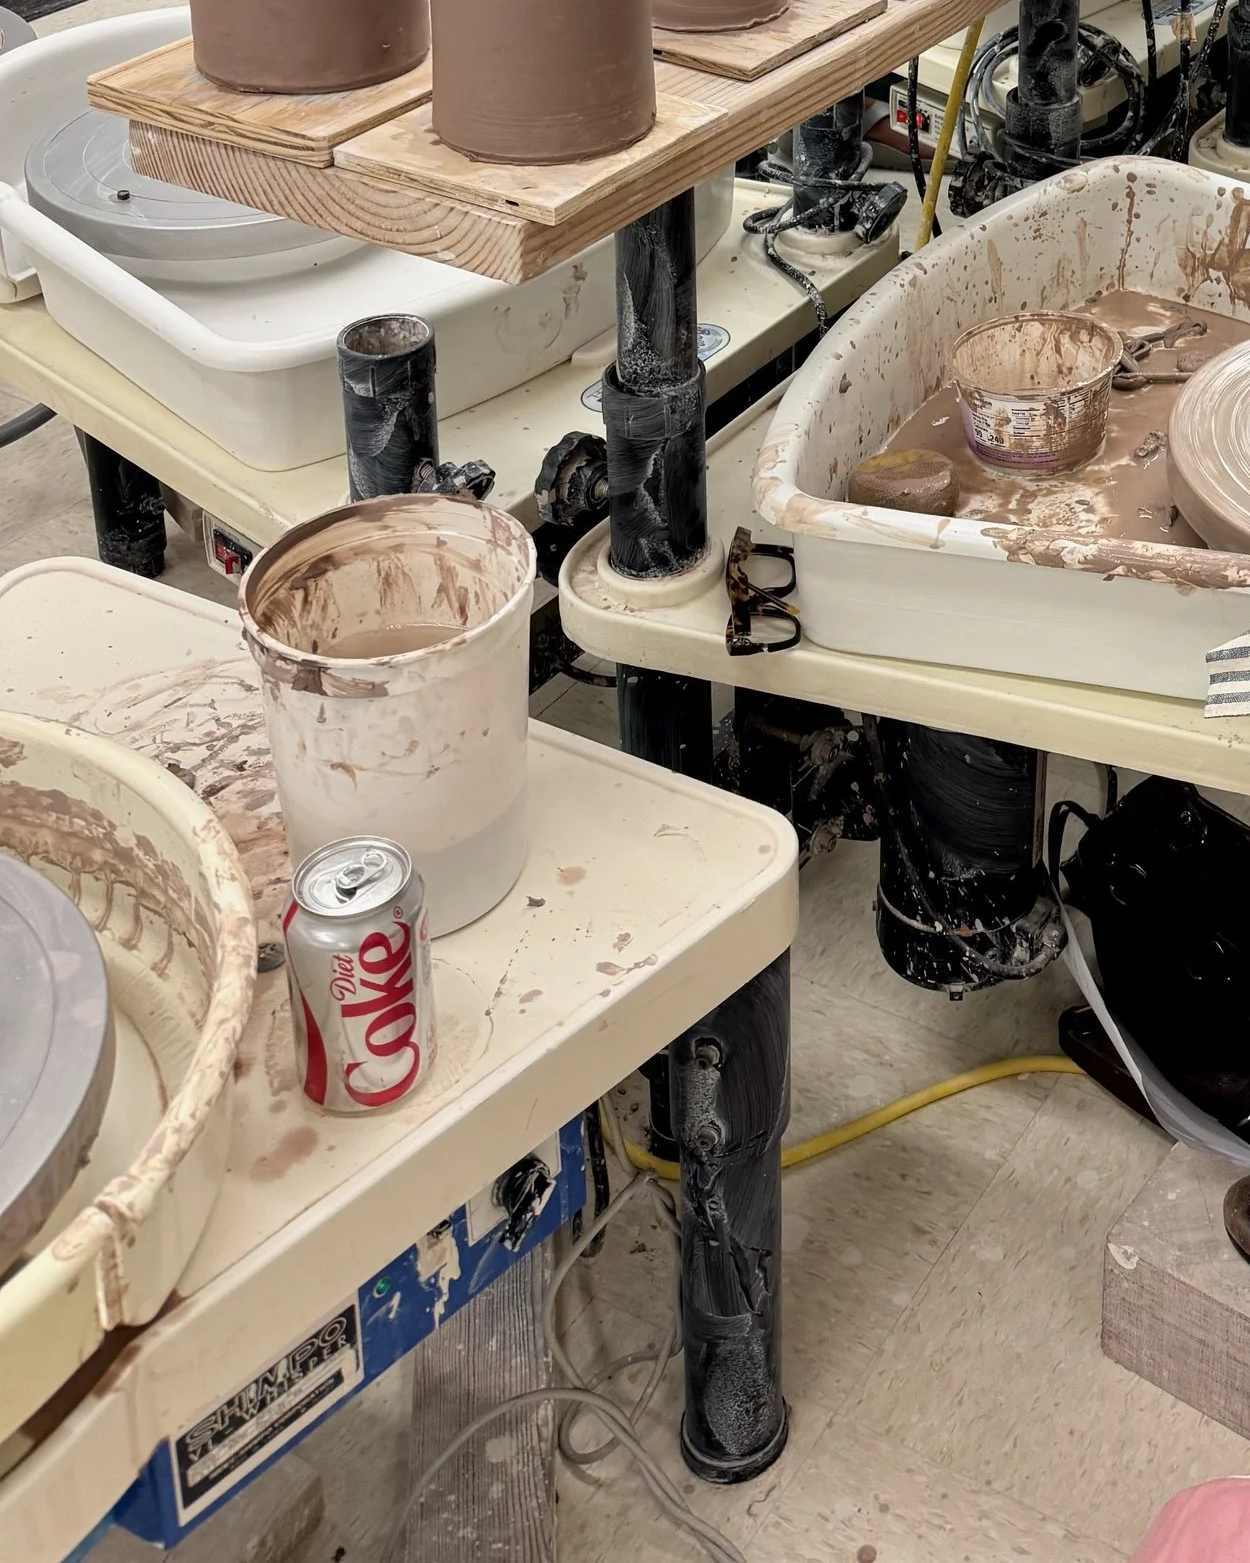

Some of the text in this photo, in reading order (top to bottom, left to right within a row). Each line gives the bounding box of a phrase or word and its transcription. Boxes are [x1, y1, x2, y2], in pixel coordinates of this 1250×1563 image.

[330, 953, 356, 1003] Diet
[341, 920, 420, 1108] Coke
[186, 1316, 347, 1447] SHIMPO
[241, 1334, 347, 1421] WHISPER
